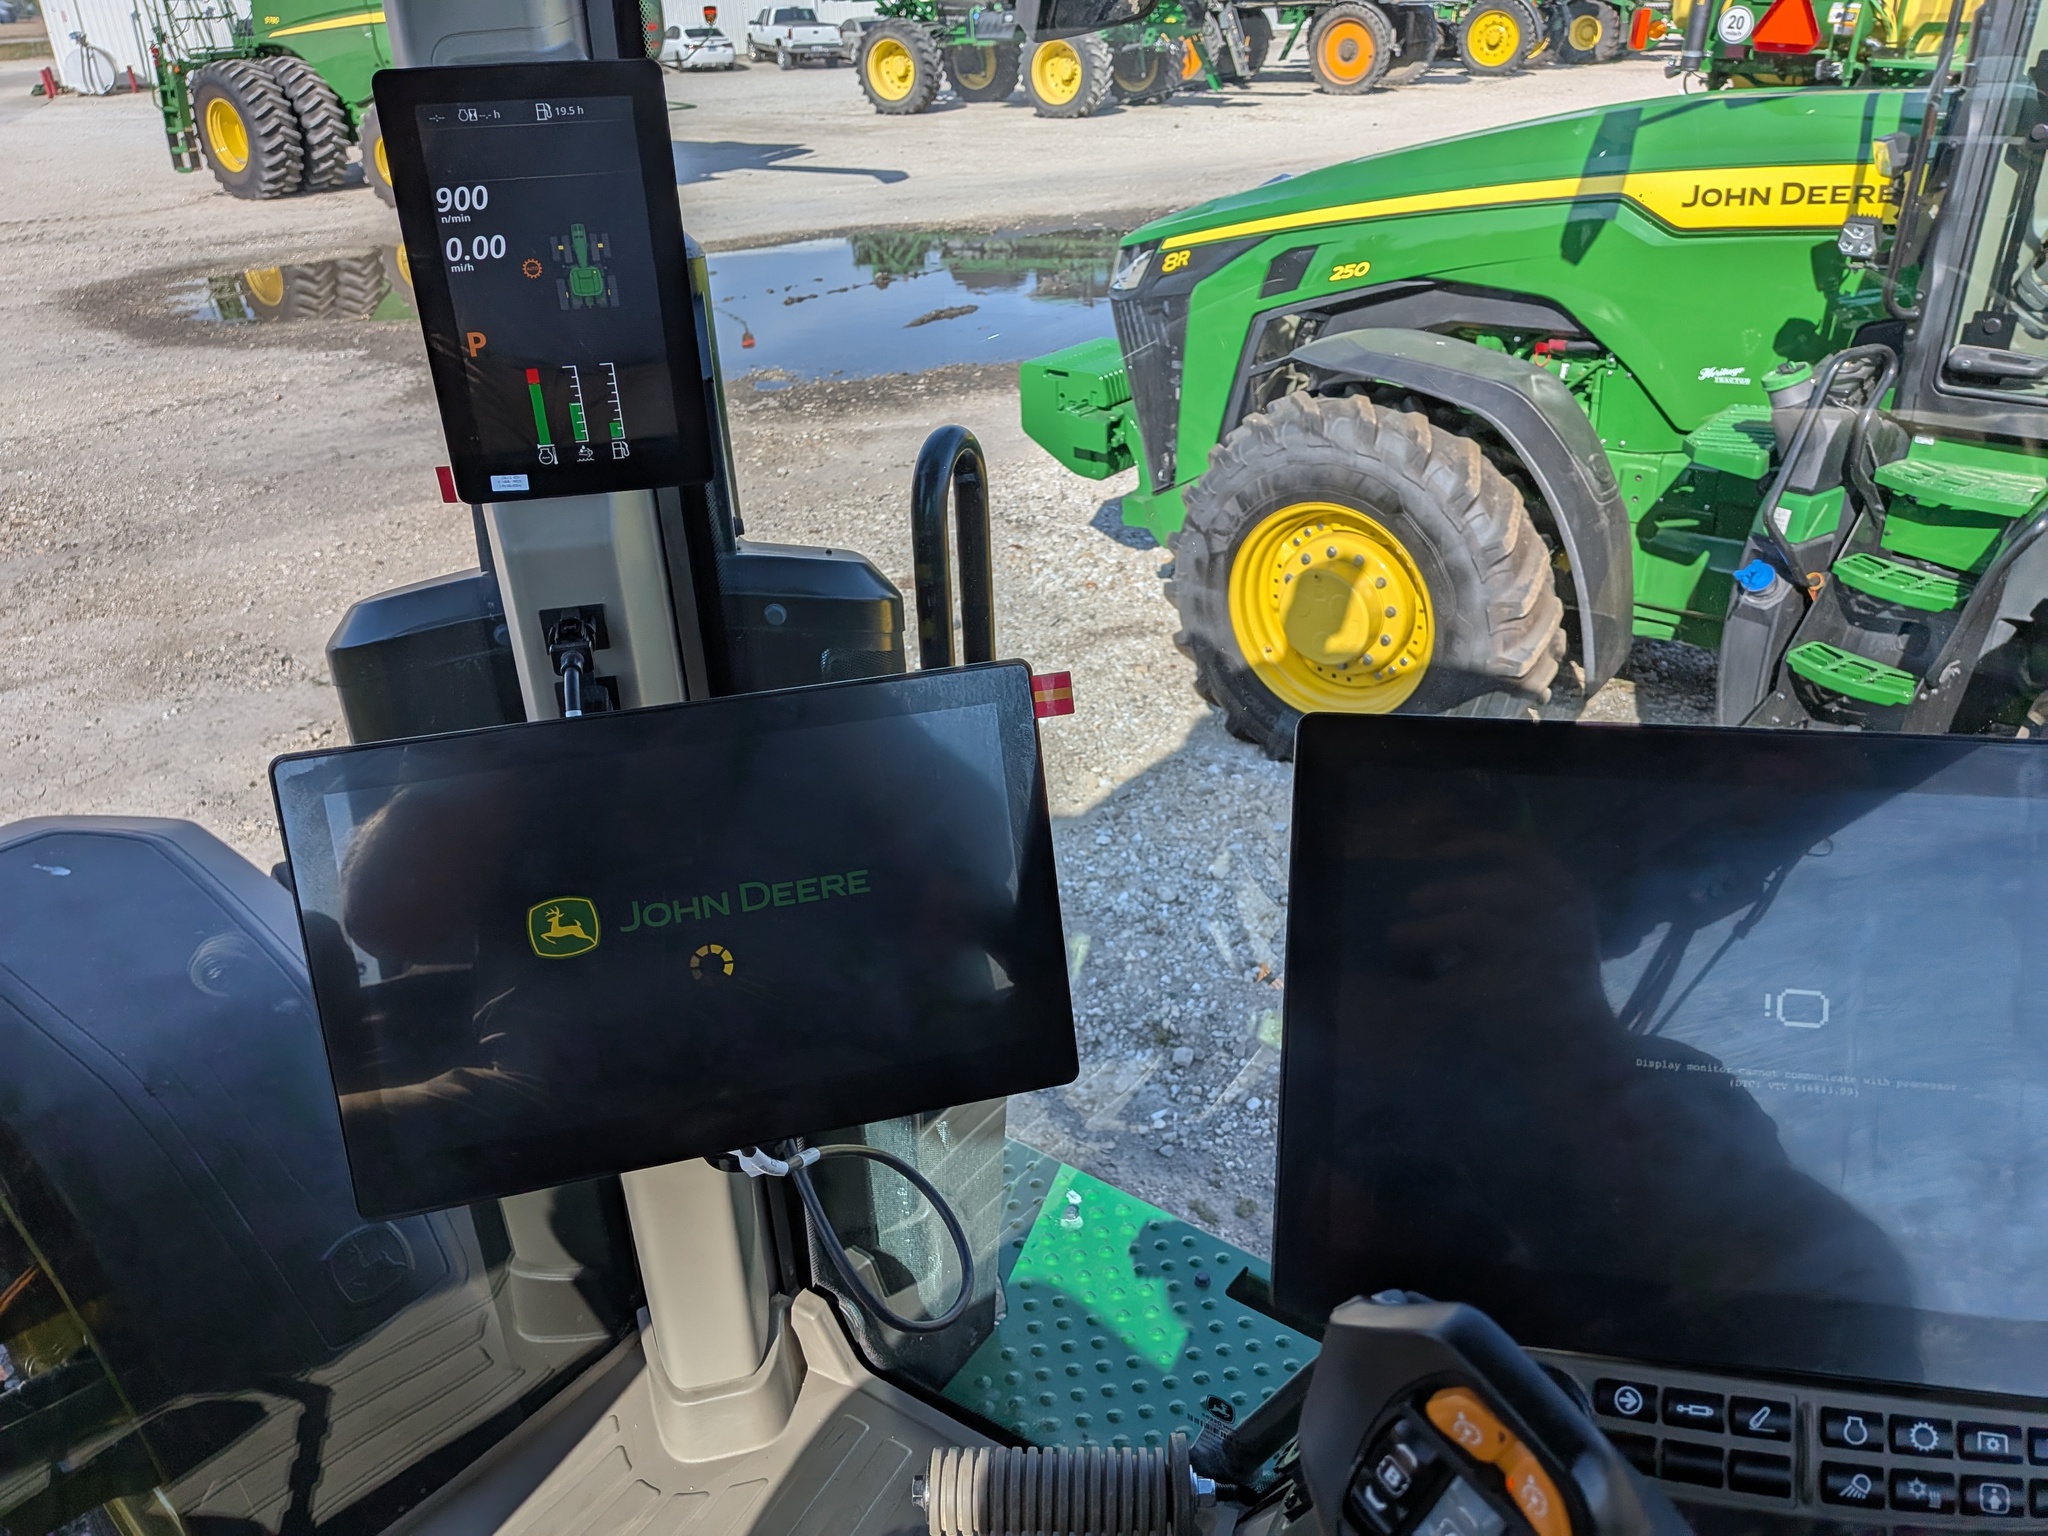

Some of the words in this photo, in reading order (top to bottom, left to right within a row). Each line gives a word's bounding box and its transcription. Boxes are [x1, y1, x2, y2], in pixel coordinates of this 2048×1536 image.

[1727, 14, 1745, 30] 20
[554, 106, 576, 117] 19.5
[577, 105, 585, 115] h
[436, 185, 489, 212] 900
[1681, 184, 1771, 207] JOHN
[1781, 182, 1893, 205] DEERE
[441, 213, 471, 224] n/min
[446, 234, 506, 262] 0.00
[450, 263, 475, 273] mi/h
[1161, 249, 1191, 273] 8R
[1328, 261, 1371, 281] 250
[467, 331, 487, 358] P
[619, 891, 731, 933] JOHN
[738, 869, 871, 912] DEERE
[1635, 1058, 1681, 1072] Display
[1686, 1062, 1733, 1074] monitor
[1784, 1071, 1857, 1083] communicate
